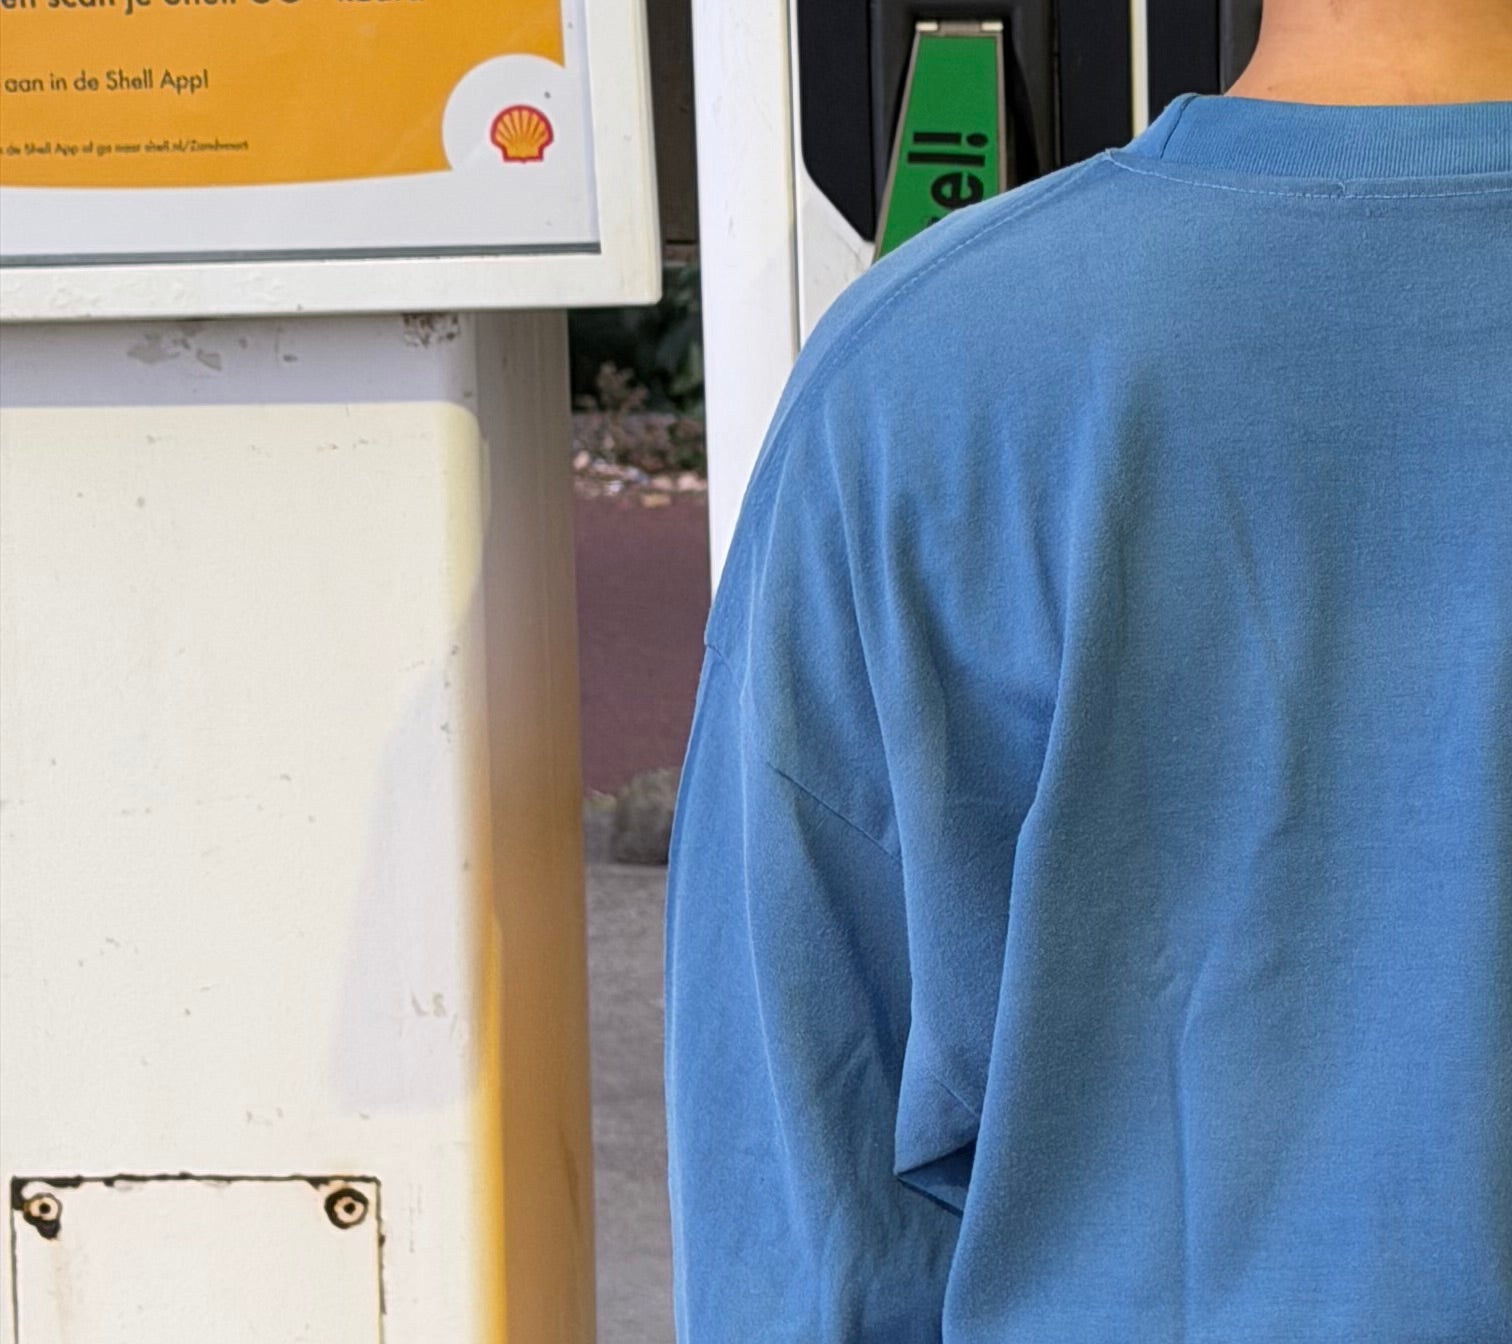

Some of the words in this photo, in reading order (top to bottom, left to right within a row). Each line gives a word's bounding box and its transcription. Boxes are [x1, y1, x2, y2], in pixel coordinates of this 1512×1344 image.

[4, 76, 45, 93] aan
[50, 72, 68, 91] in
[73, 70, 100, 92] de
[105, 68, 154, 91] Shell
[906, 131, 989, 224] el!
